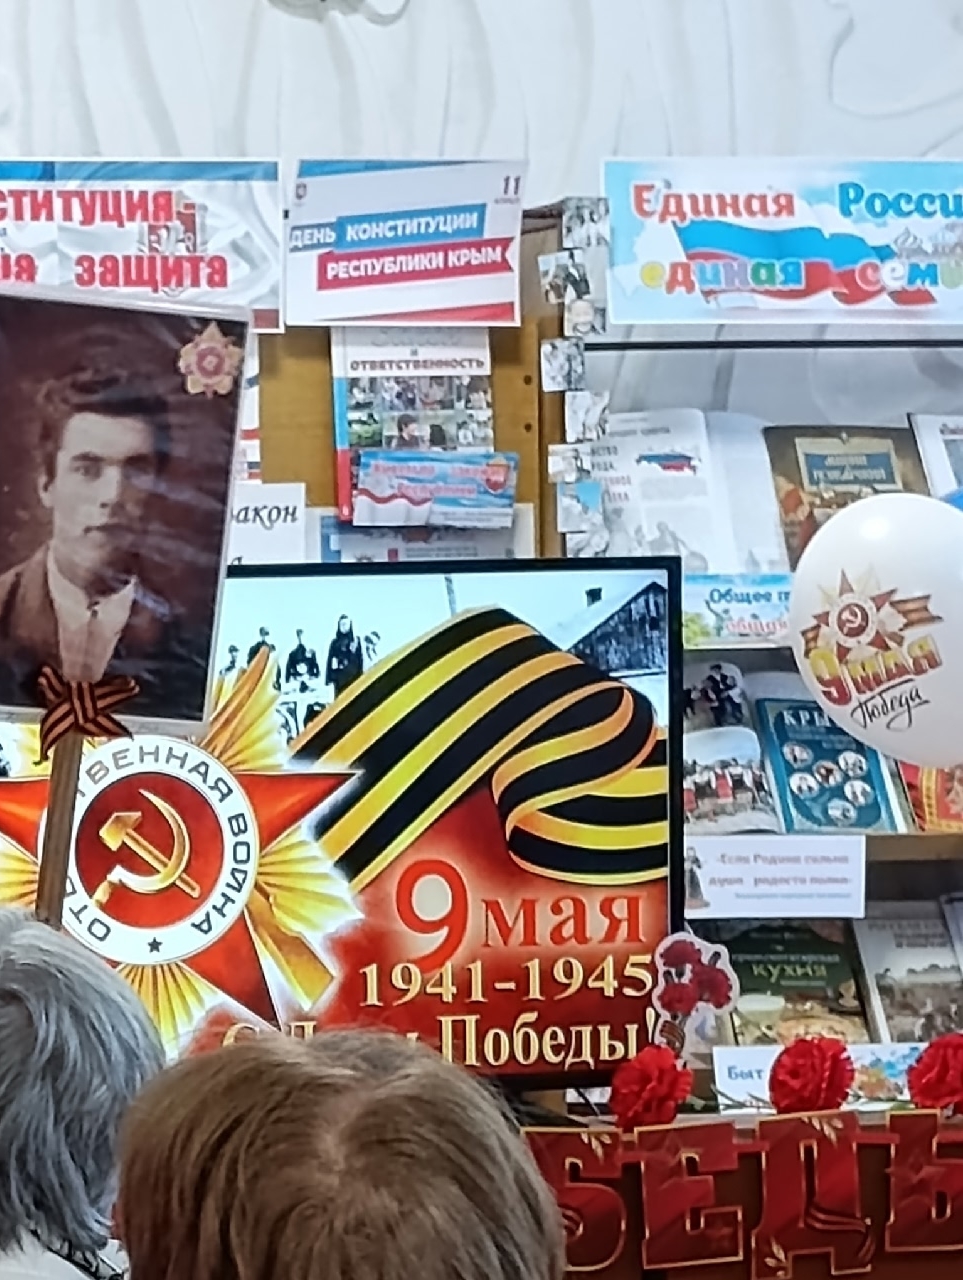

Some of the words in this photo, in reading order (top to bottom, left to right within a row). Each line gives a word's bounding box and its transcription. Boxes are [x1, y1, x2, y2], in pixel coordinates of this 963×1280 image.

[502, 175, 521, 196] 11
[633, 182, 795, 223] Единая
[290, 228, 336, 248] ДЕНЬ
[346, 212, 479, 242] КОНСТИТУЦИИ
[75, 254, 228, 293] защита
[327, 252, 445, 280] РЕСПУБЛИКИ
[448, 245, 503, 268] КРЫМ
[640, 261, 805, 293] единая
[350, 358, 485, 372] ОТВЕТСТВЕННОСТЬ
[231, 504, 298, 530] акон
[710, 588, 772, 605] Общее
[809, 648, 852, 706] 9
[783, 709, 832, 727] КРЫ
[851, 678, 930, 732] Победа
[396, 859, 469, 975] 9
[481, 894, 648, 948] мая
[359, 954, 653, 1008] 1941-1945
[438, 1006, 655, 1070] Победы!
[727, 1064, 765, 1081] Быт
